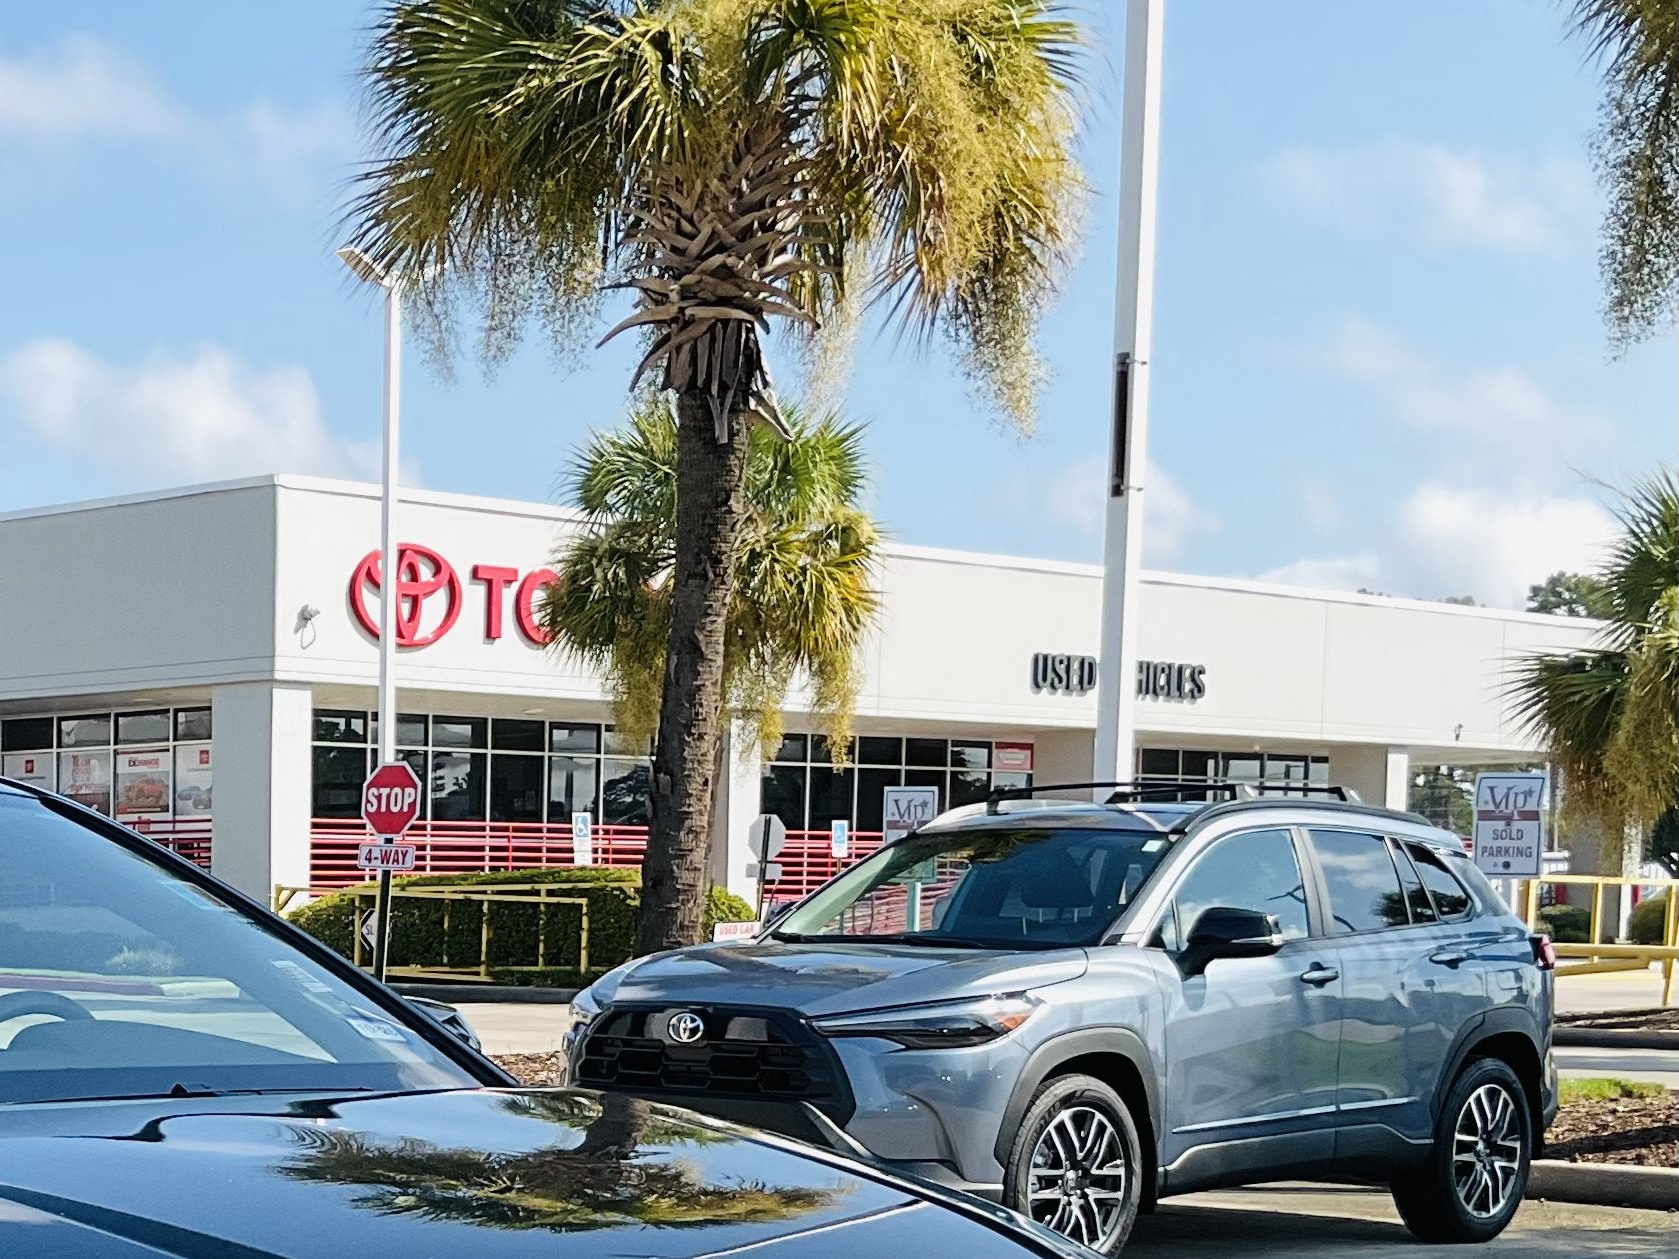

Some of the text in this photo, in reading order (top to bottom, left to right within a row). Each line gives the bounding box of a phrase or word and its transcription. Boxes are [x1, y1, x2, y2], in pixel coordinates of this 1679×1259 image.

[1031, 652, 1207, 703] USED HICLES
[366, 786, 416, 813] STOP
[1492, 828, 1524, 841] SOLD
[364, 847, 409, 866] 4-WAY
[1481, 845, 1533, 858] PARKING
[365, 923, 375, 936] SL
[719, 924, 738, 935] USED
